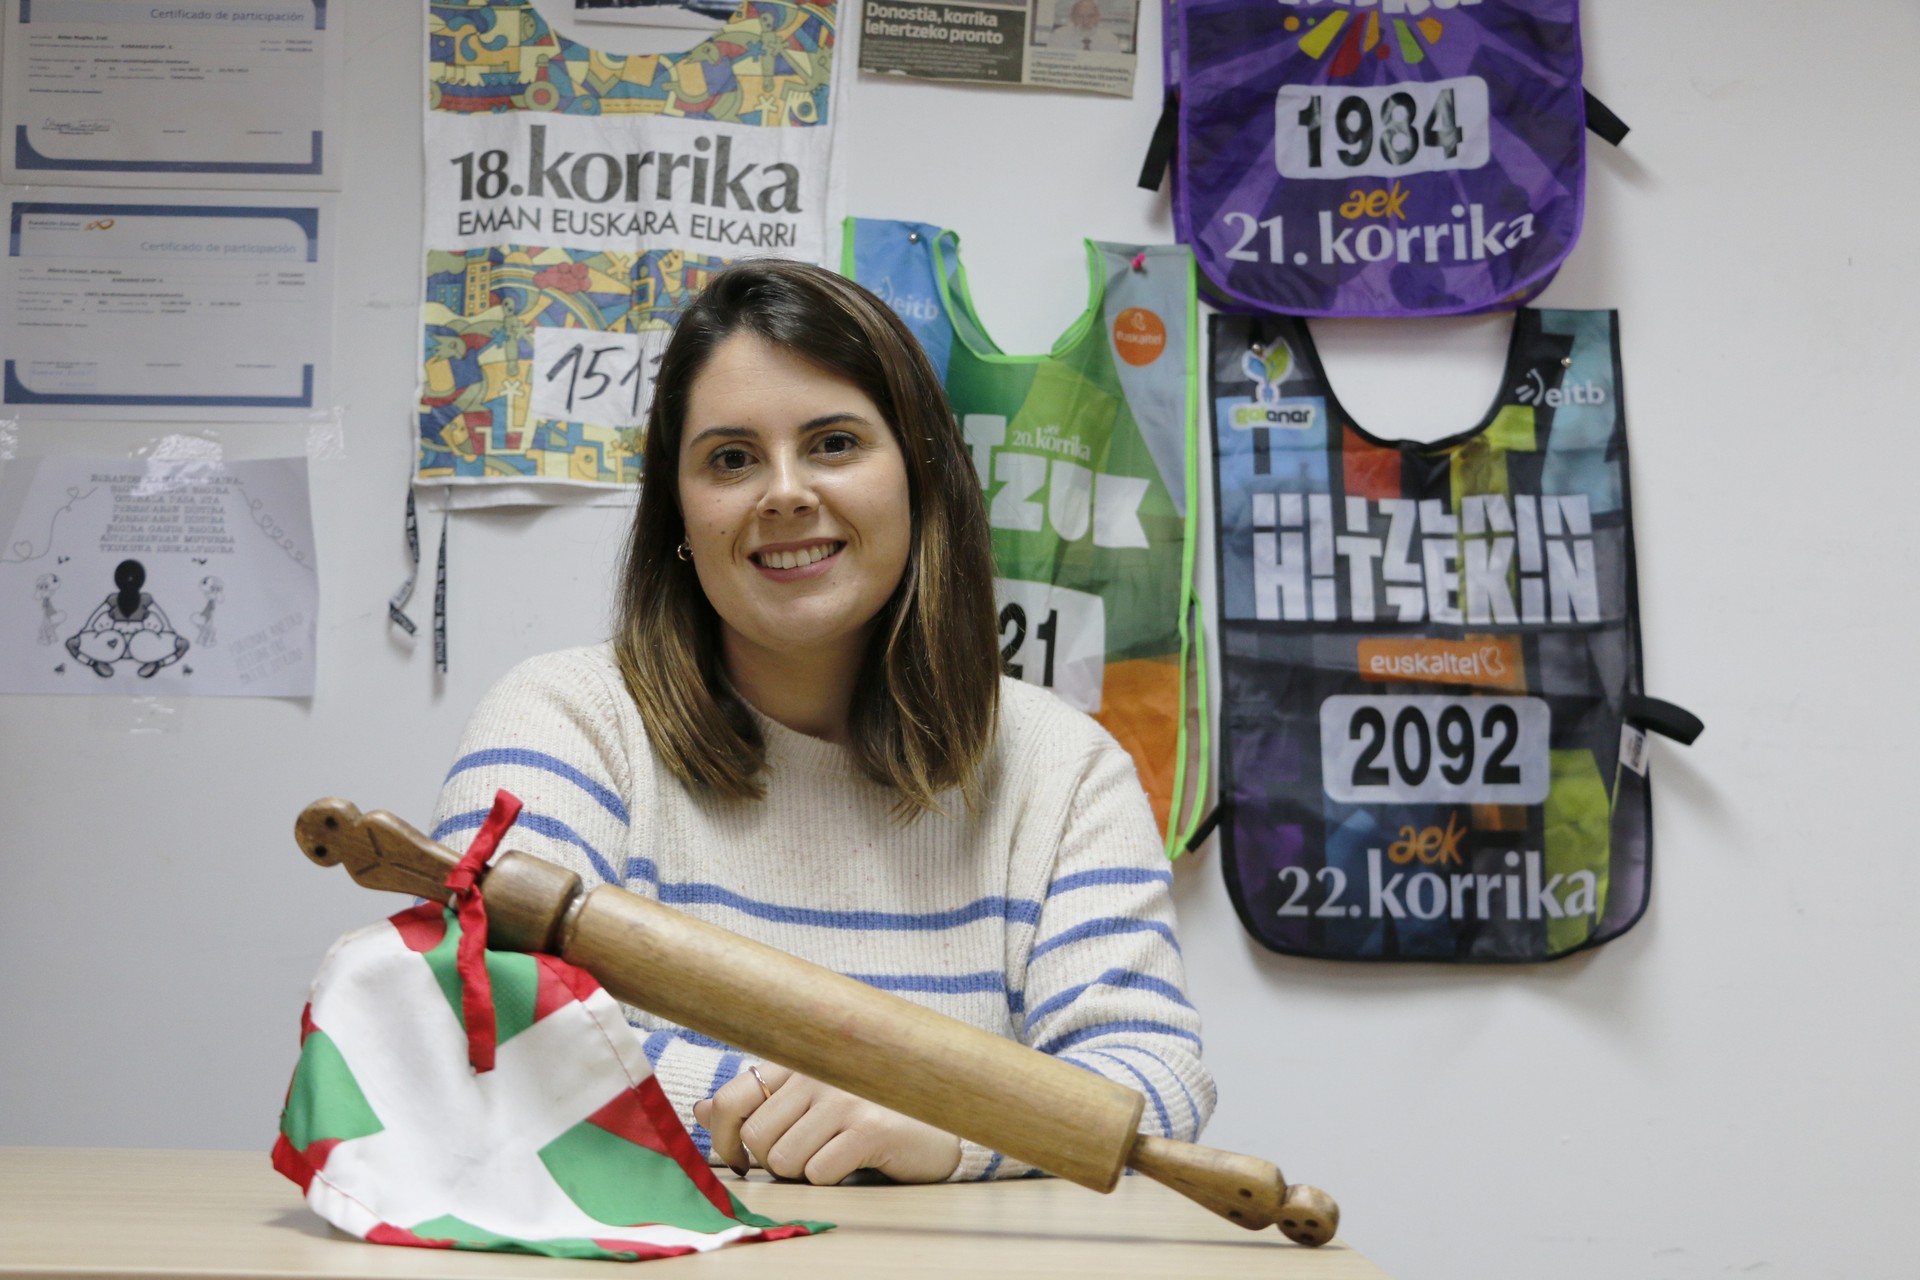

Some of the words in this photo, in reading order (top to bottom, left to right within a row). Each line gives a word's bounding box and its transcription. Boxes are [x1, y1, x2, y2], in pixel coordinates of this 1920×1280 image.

[151, 8, 211, 20] Certificado
[215, 10, 229, 20] de
[232, 11, 304, 22] participación
[865, 19, 948, 39] lehertzeko
[949, 29, 1003, 44] pronto
[866, 2, 941, 24] Donostia,
[944, 8, 998, 27] korrika
[1297, 88, 1463, 168] 1984
[1340, 180, 1411, 221] aek
[458, 207, 541, 237] EMAN
[552, 209, 679, 238] EUSKARA
[690, 213, 796, 247] ELKARRI
[1222, 211, 1308, 266] 21.
[1319, 204, 1534, 265] korrika
[140, 241, 201, 252] Certificado
[206, 243, 220, 252] de
[223, 243, 296, 254] participación
[1545, 380, 1605, 407] eitb
[1252, 493, 1600, 624] HITZEKIN
[1370, 652, 1481, 676] euskaltel
[1349, 704, 1521, 786] 2092
[1388, 812, 1467, 866] aek
